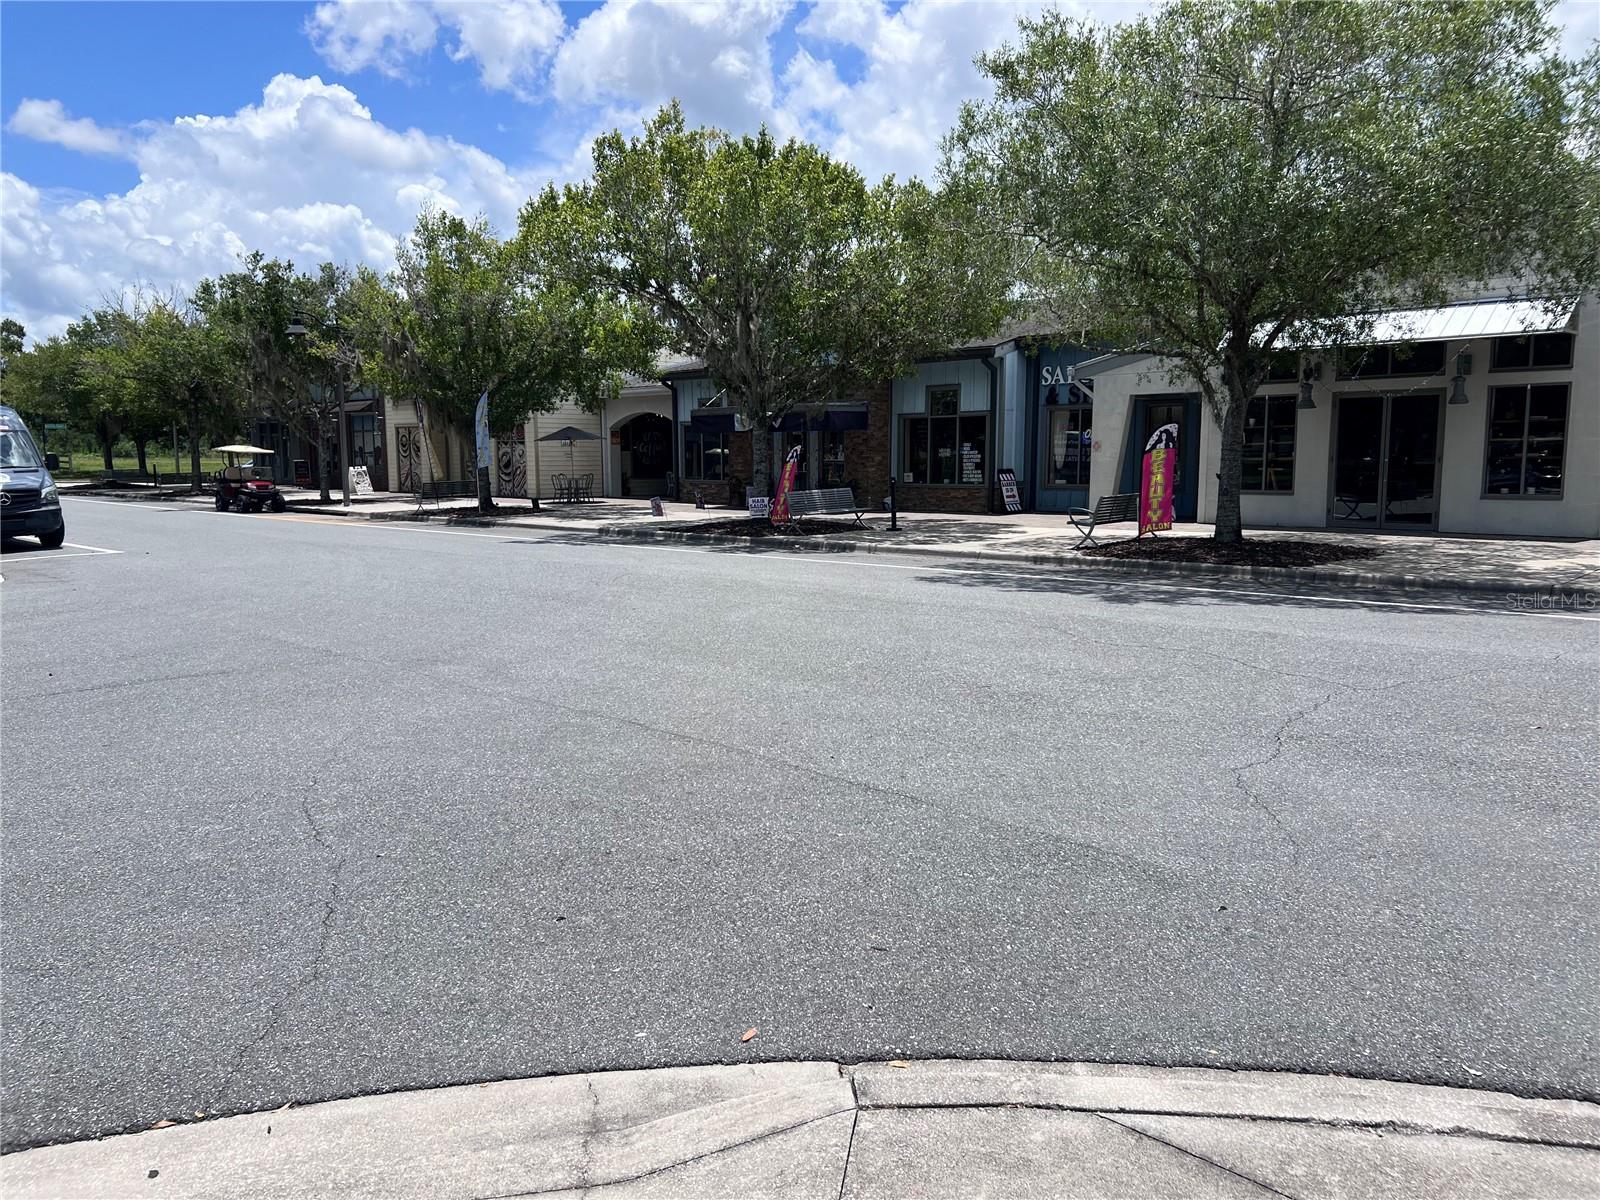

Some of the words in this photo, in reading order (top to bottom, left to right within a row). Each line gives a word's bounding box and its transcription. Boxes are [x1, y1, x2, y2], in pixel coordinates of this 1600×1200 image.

[1042, 365, 1090, 385] SAL
[1148, 449, 1166, 521] BEAUTY
[1141, 522, 1170, 533] SALON
